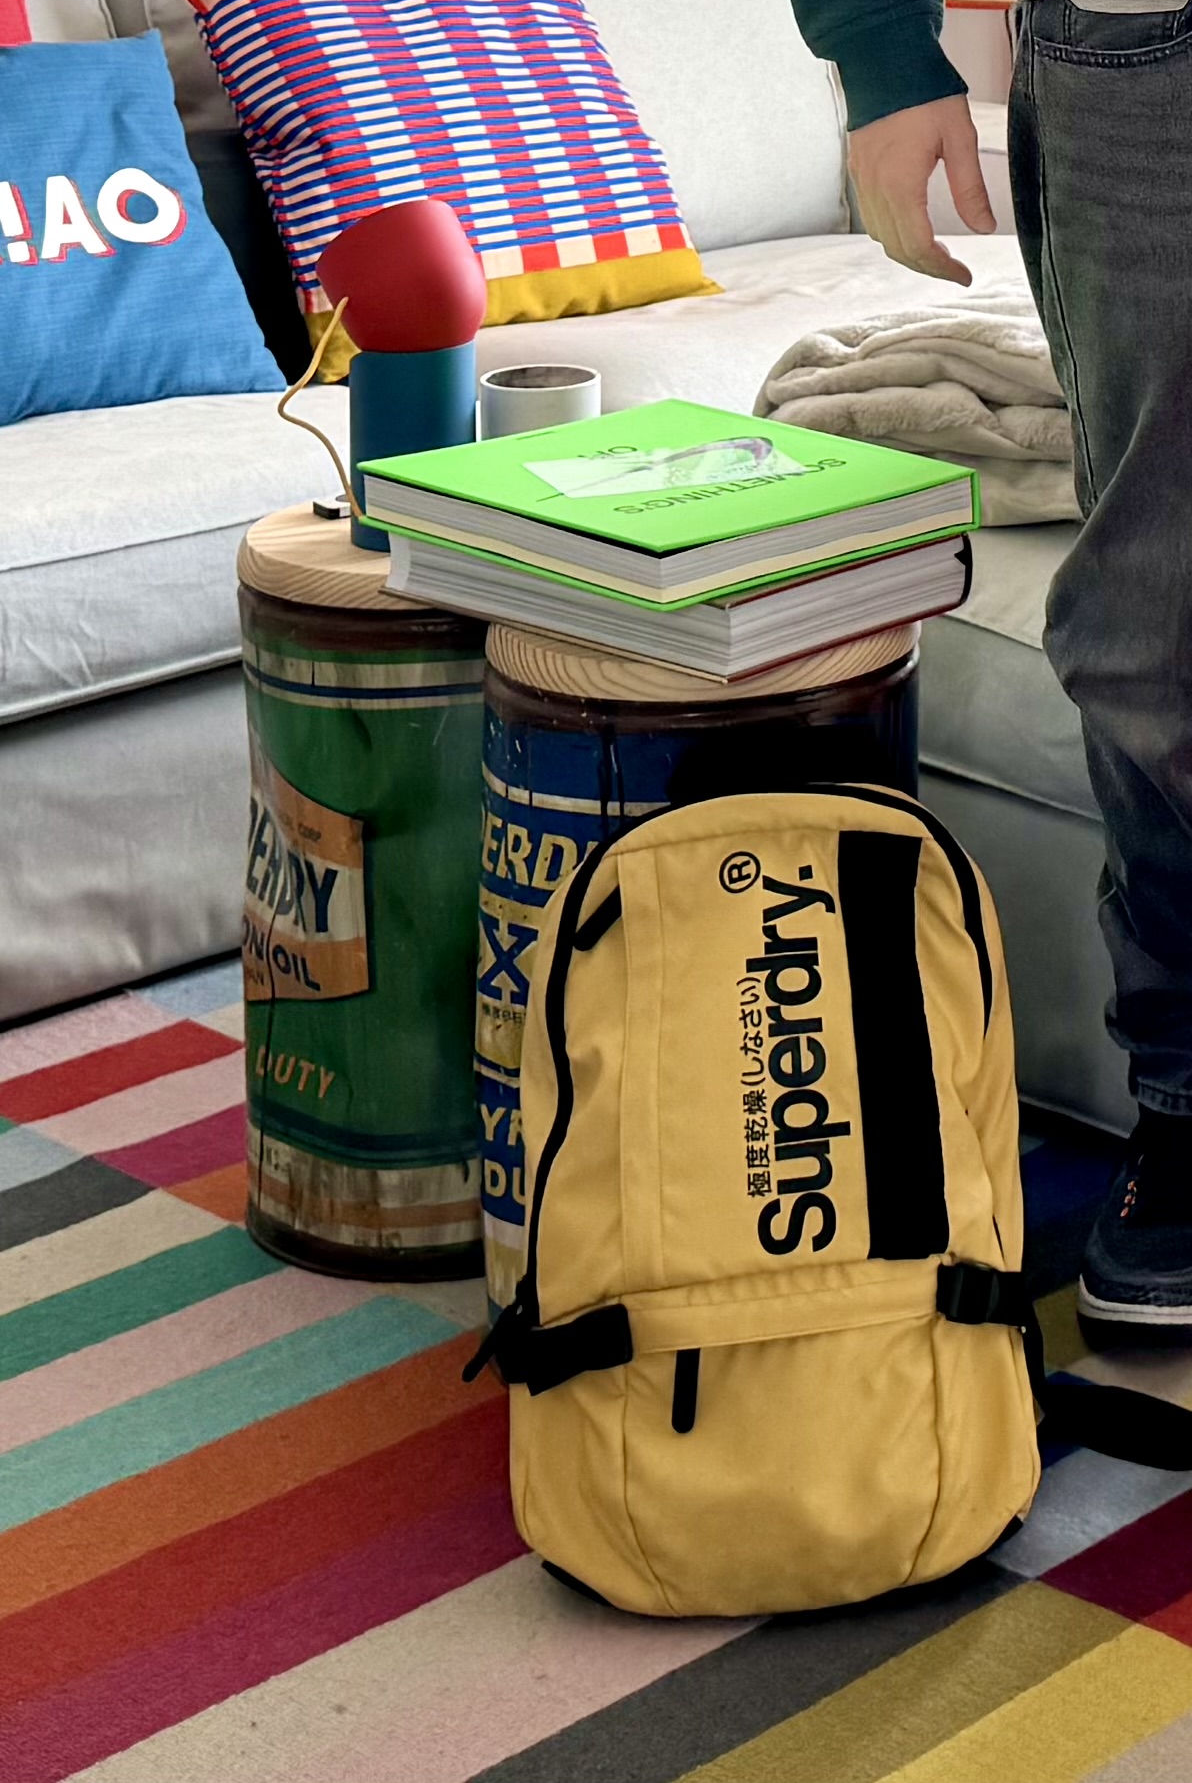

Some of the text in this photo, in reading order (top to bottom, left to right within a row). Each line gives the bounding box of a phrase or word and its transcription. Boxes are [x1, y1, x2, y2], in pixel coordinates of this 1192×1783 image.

[481, 804, 600, 892] ERD
[271, 943, 321, 992] OIL
[255, 1045, 336, 1099] DUTY
